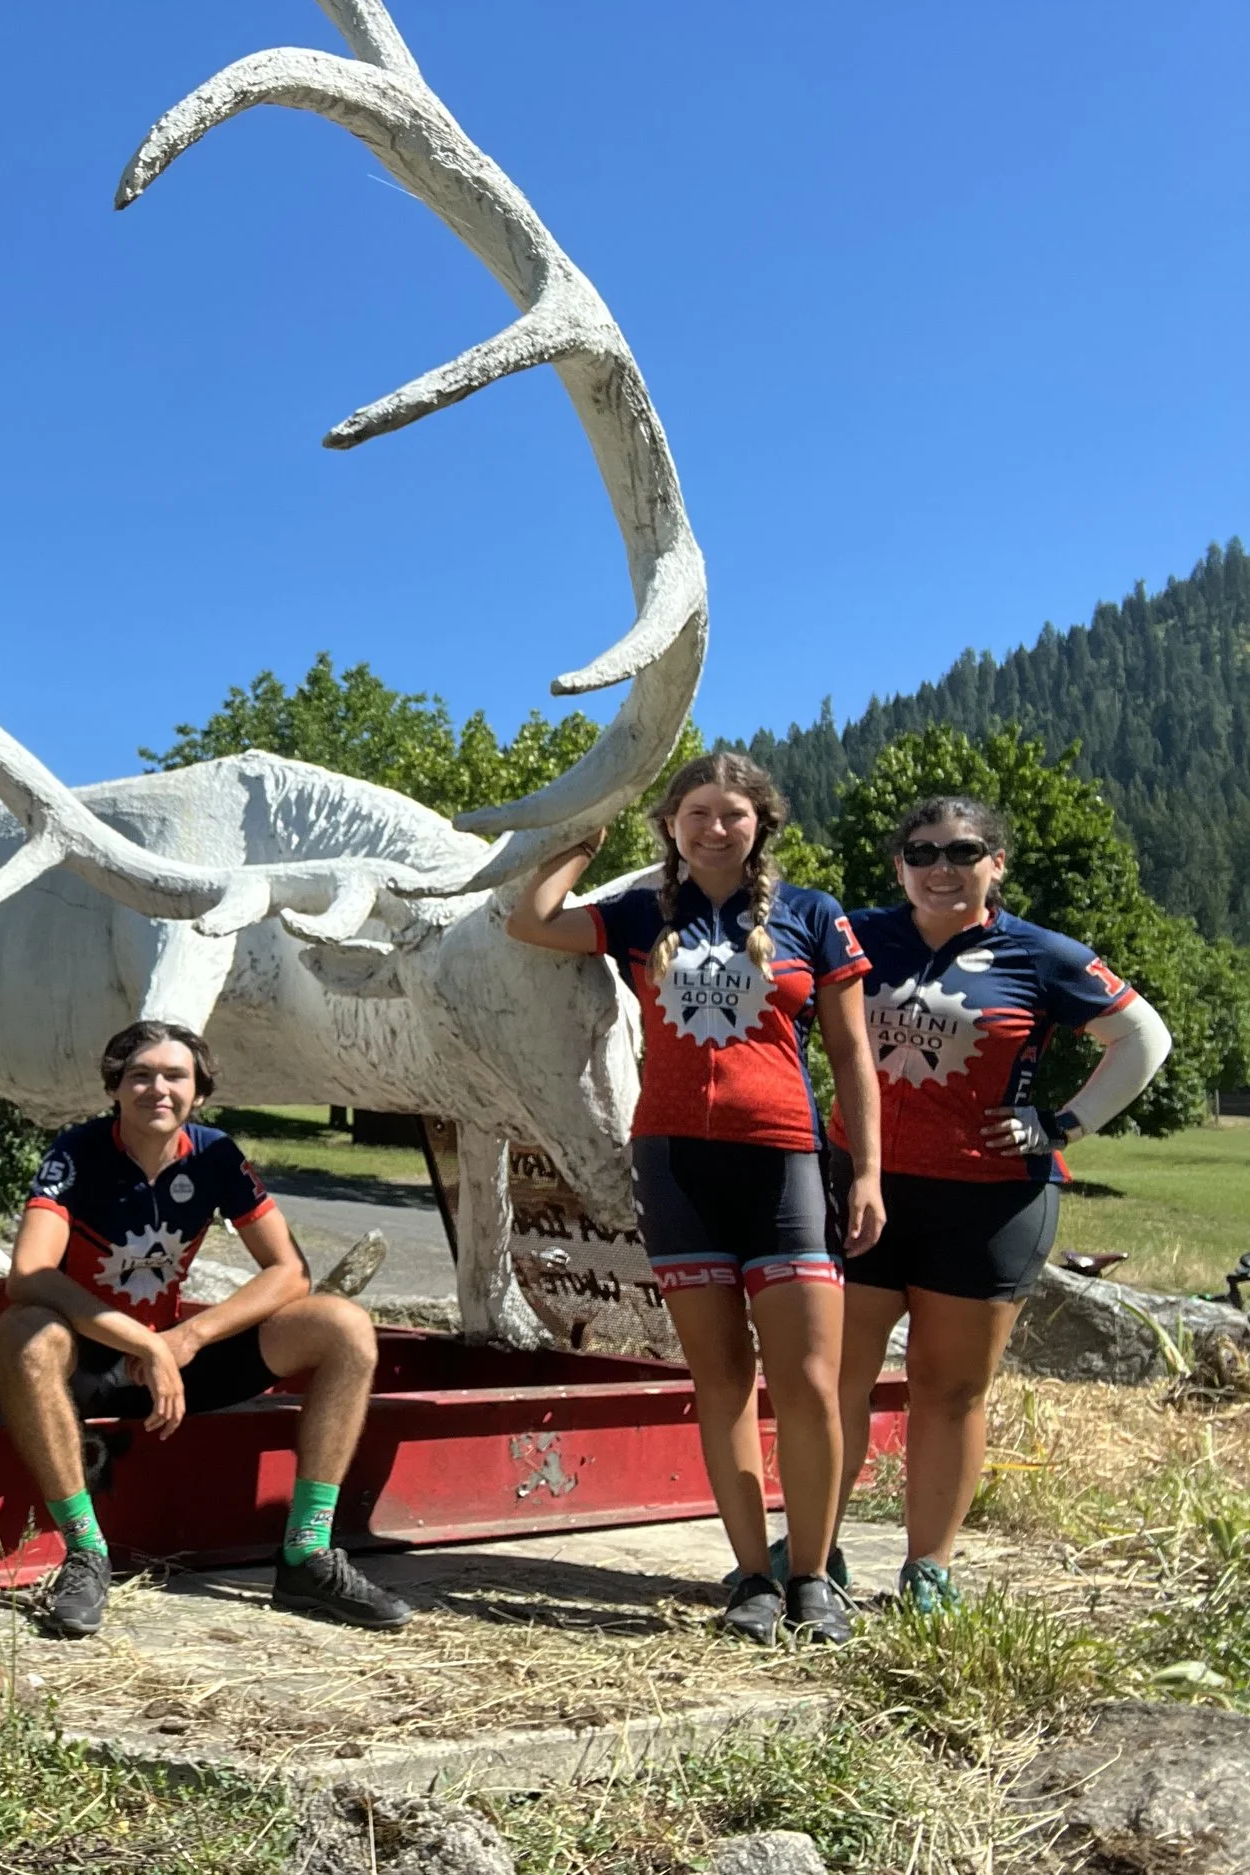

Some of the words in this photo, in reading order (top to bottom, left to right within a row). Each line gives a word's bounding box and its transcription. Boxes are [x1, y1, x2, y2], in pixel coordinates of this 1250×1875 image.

[673, 973, 751, 990] ILLINI
[681, 991, 739, 1006] 4000
[870, 1010, 959, 1035] ILLINI
[878, 1030, 943, 1050] 4000
[40, 1160, 65, 1181] 15
